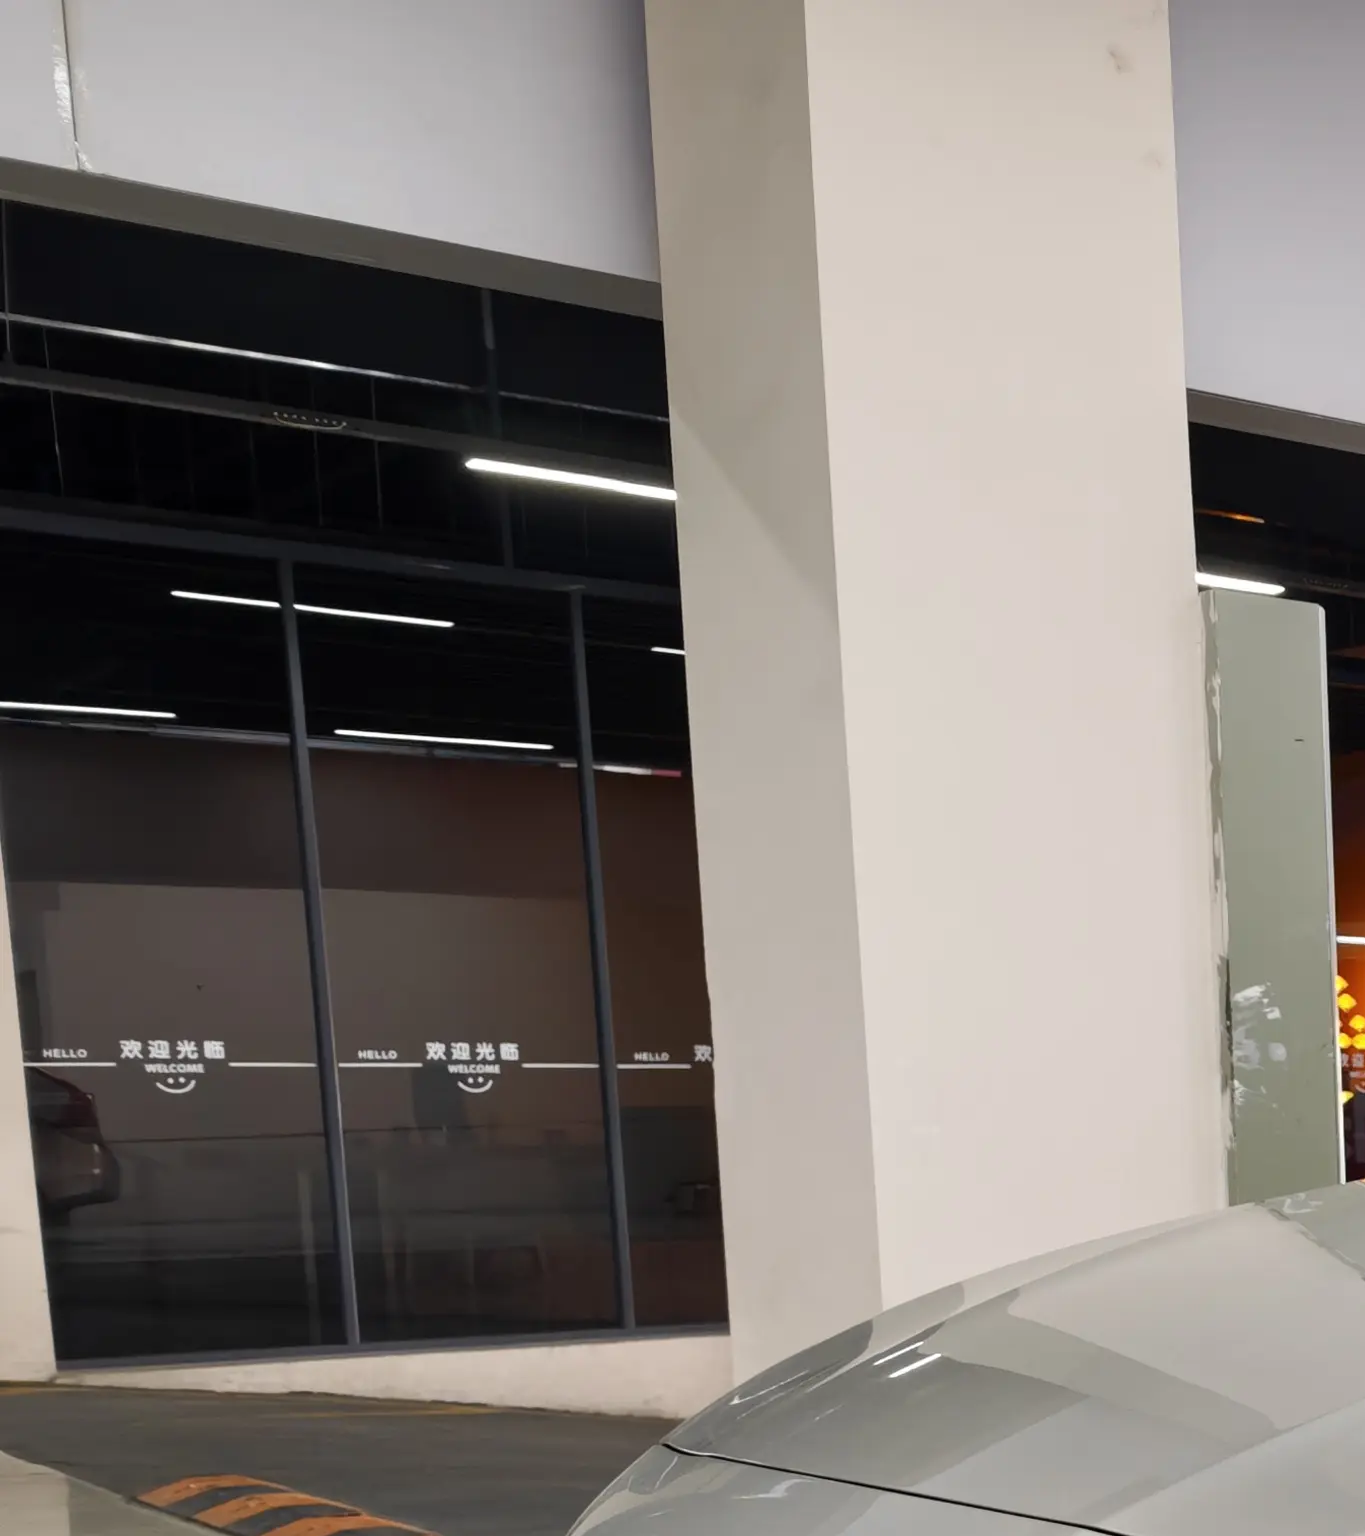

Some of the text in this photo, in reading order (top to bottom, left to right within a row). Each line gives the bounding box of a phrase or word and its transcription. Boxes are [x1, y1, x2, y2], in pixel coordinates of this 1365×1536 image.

[43, 1049, 88, 1059] HELLO
[119, 1040, 226, 1059] 欢迎光临
[426, 1041, 519, 1060] 欢迎光临
[357, 1050, 398, 1060] HELLO
[633, 1052, 670, 1061] HELLO
[144, 1063, 205, 1073] WELCOME
[447, 1064, 501, 1074] WELCOME
